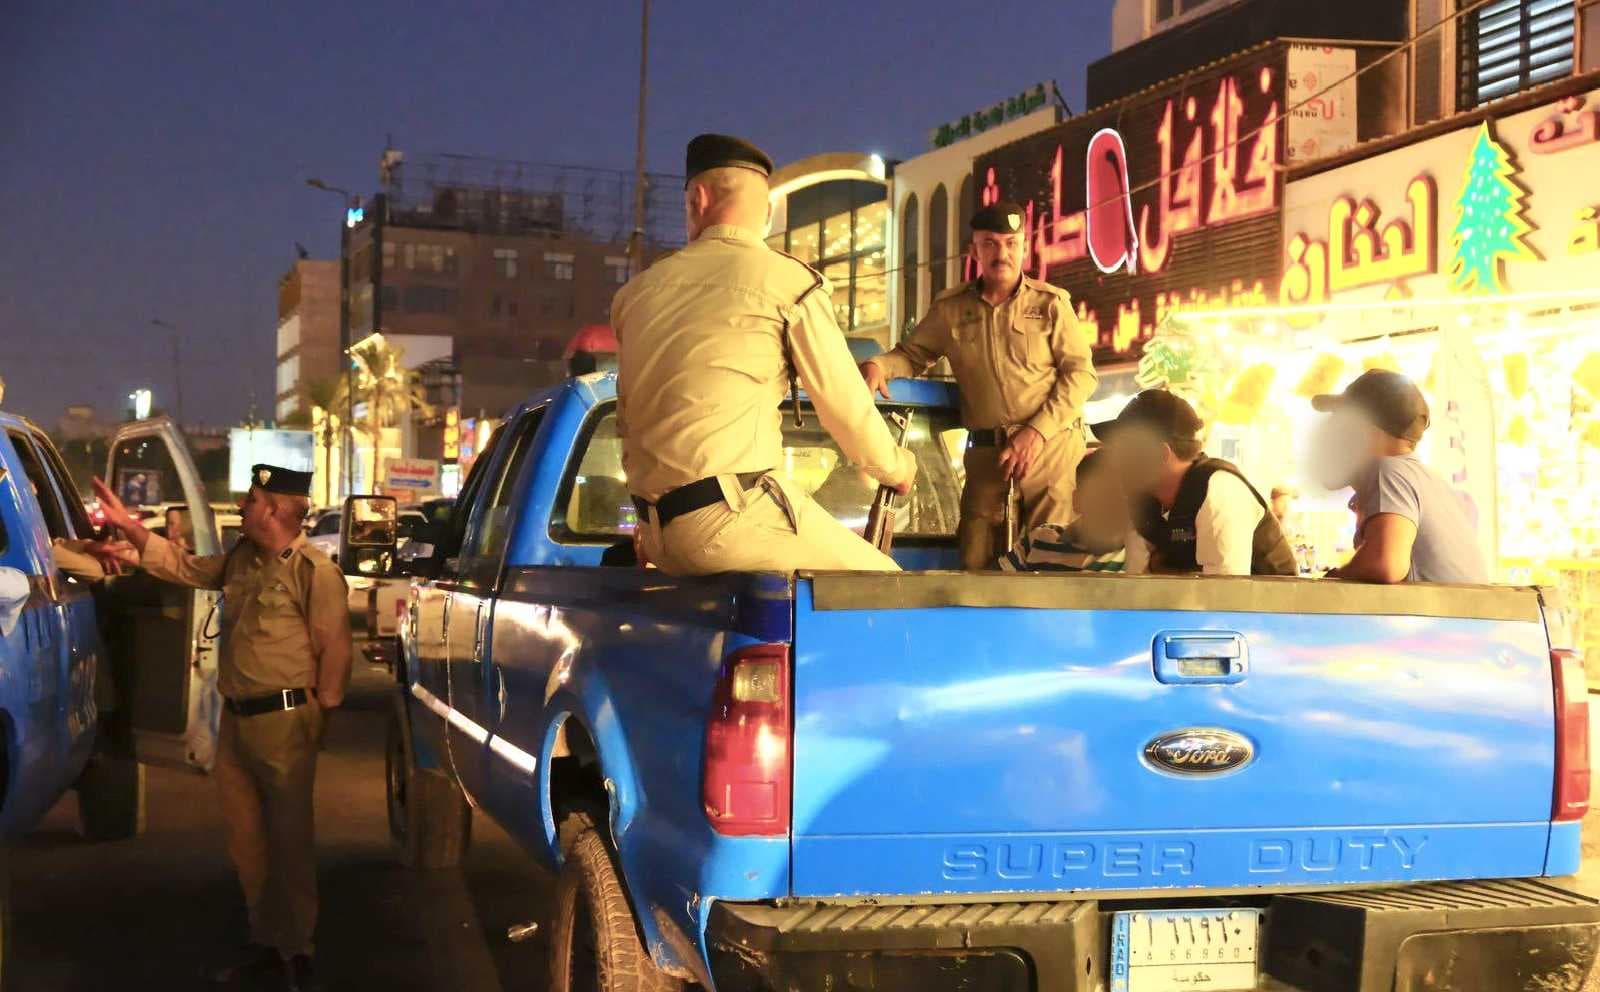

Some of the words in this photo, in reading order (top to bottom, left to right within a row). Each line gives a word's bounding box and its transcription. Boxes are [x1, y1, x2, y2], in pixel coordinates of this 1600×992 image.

[1139, 67, 1278, 273] فلافل
[941, 839, 1197, 881] SUPER
[1248, 835, 1429, 873] DUTY
